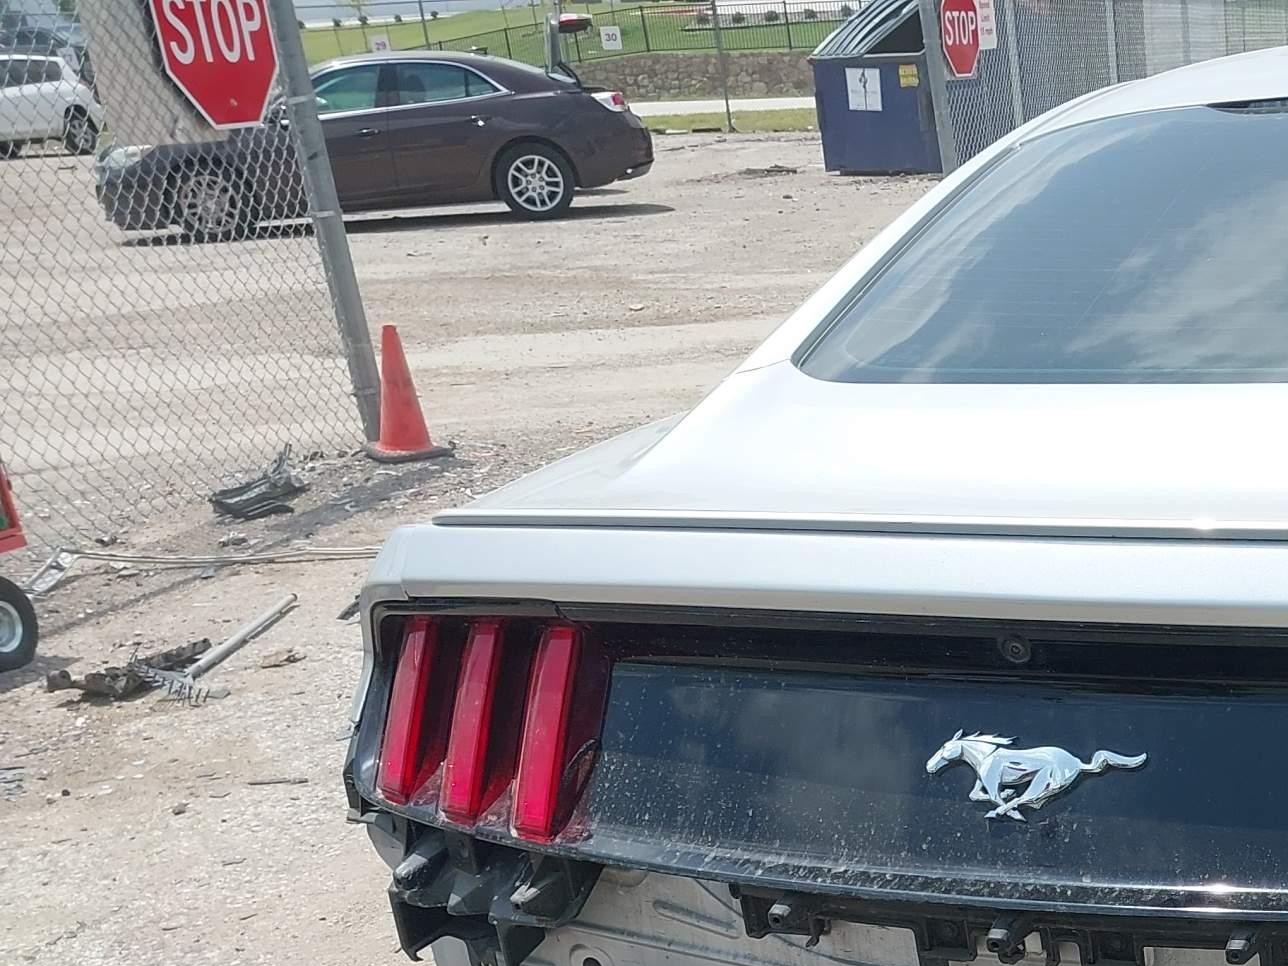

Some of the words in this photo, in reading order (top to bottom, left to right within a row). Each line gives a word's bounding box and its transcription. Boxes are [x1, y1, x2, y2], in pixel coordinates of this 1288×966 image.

[162, 0, 262, 64] STOP
[604, 32, 618, 42] 30
[945, 11, 976, 46] STOP
